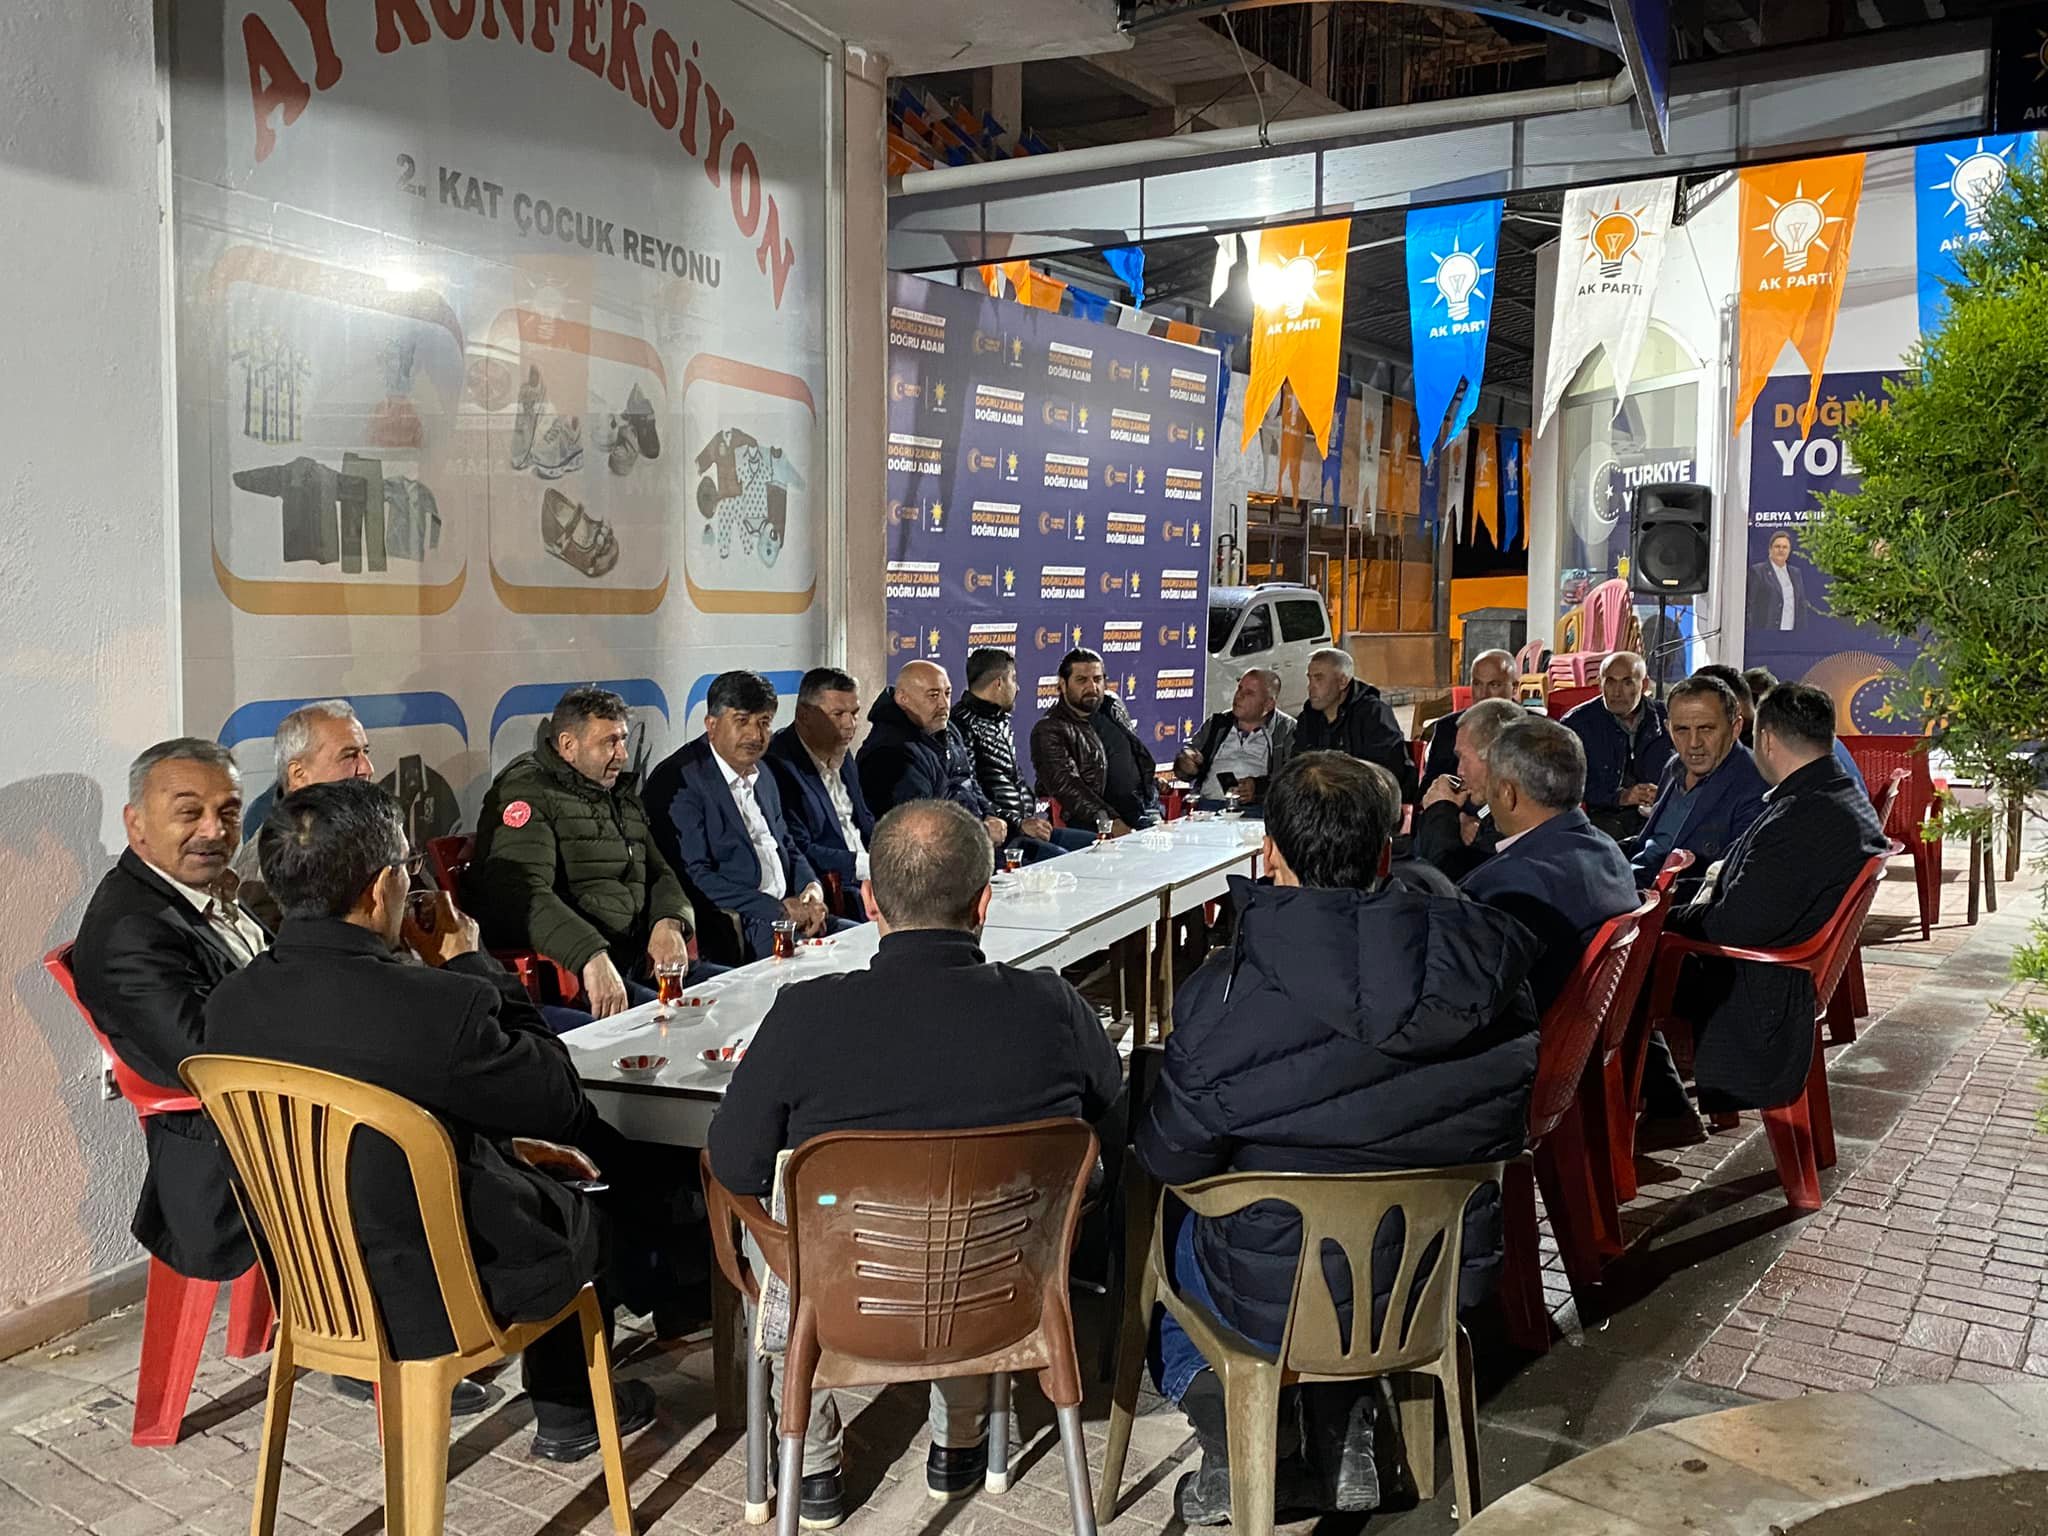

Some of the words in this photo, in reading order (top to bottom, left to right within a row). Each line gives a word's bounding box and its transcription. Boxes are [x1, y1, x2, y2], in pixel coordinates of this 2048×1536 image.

[242, 0, 343, 163] AY
[397, 153, 426, 199] 2.
[439, 166, 504, 219] KAT
[513, 193, 615, 256] ÇOCUK
[623, 228, 721, 289] REYONU
[1578, 283, 1597, 296] AK
[1758, 277, 1782, 292] AK
[1429, 325, 1448, 338] AK
[975, 407, 1001, 423] DOĞRU
[1001, 412, 1024, 426] ADAM
[1774, 394, 1889, 429] DOĞR
[918, 461, 942, 475] ADAM
[1755, 511, 1792, 521] DERYA
[971, 523, 997, 537] DOĞRU
[998, 526, 1020, 538] ADAM
[886, 584, 916, 598] DOĞRU
[916, 586, 940, 598] ADAM
